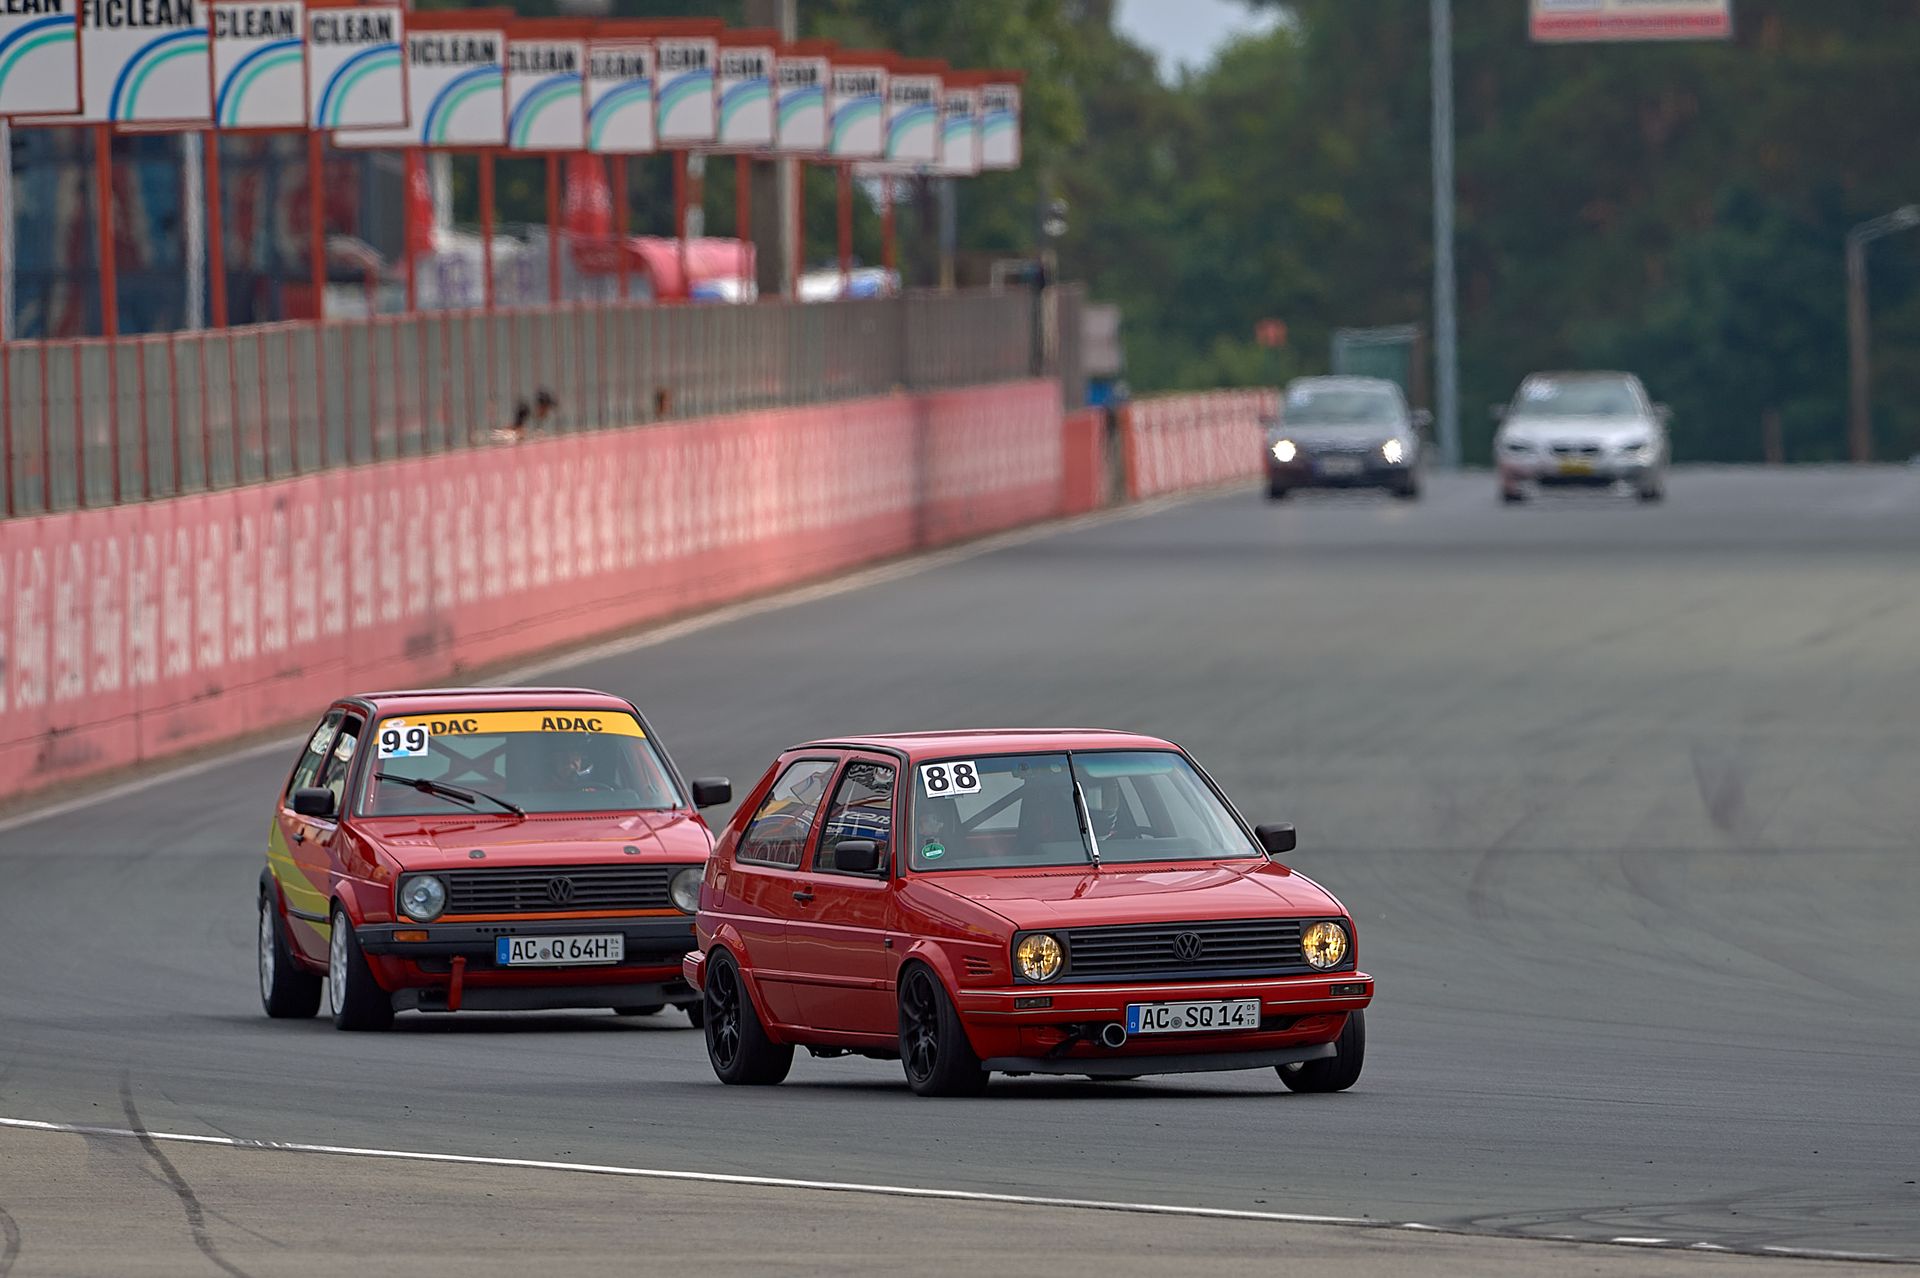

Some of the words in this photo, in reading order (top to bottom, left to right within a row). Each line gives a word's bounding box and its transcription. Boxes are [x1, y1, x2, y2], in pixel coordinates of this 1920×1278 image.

[215, 9, 294, 38] CLEAN
[312, 15, 392, 43] CLEAN
[541, 716, 603, 732] ADAC
[382, 729, 425, 753] 99
[926, 763, 977, 792] 88
[512, 940, 537, 960] AC
[552, 939, 565, 959] Q
[570, 938, 608, 959] 64H
[1142, 1008, 1170, 1030] AC
[1185, 1006, 1213, 1028] SQ
[1218, 1004, 1244, 1026] 14
